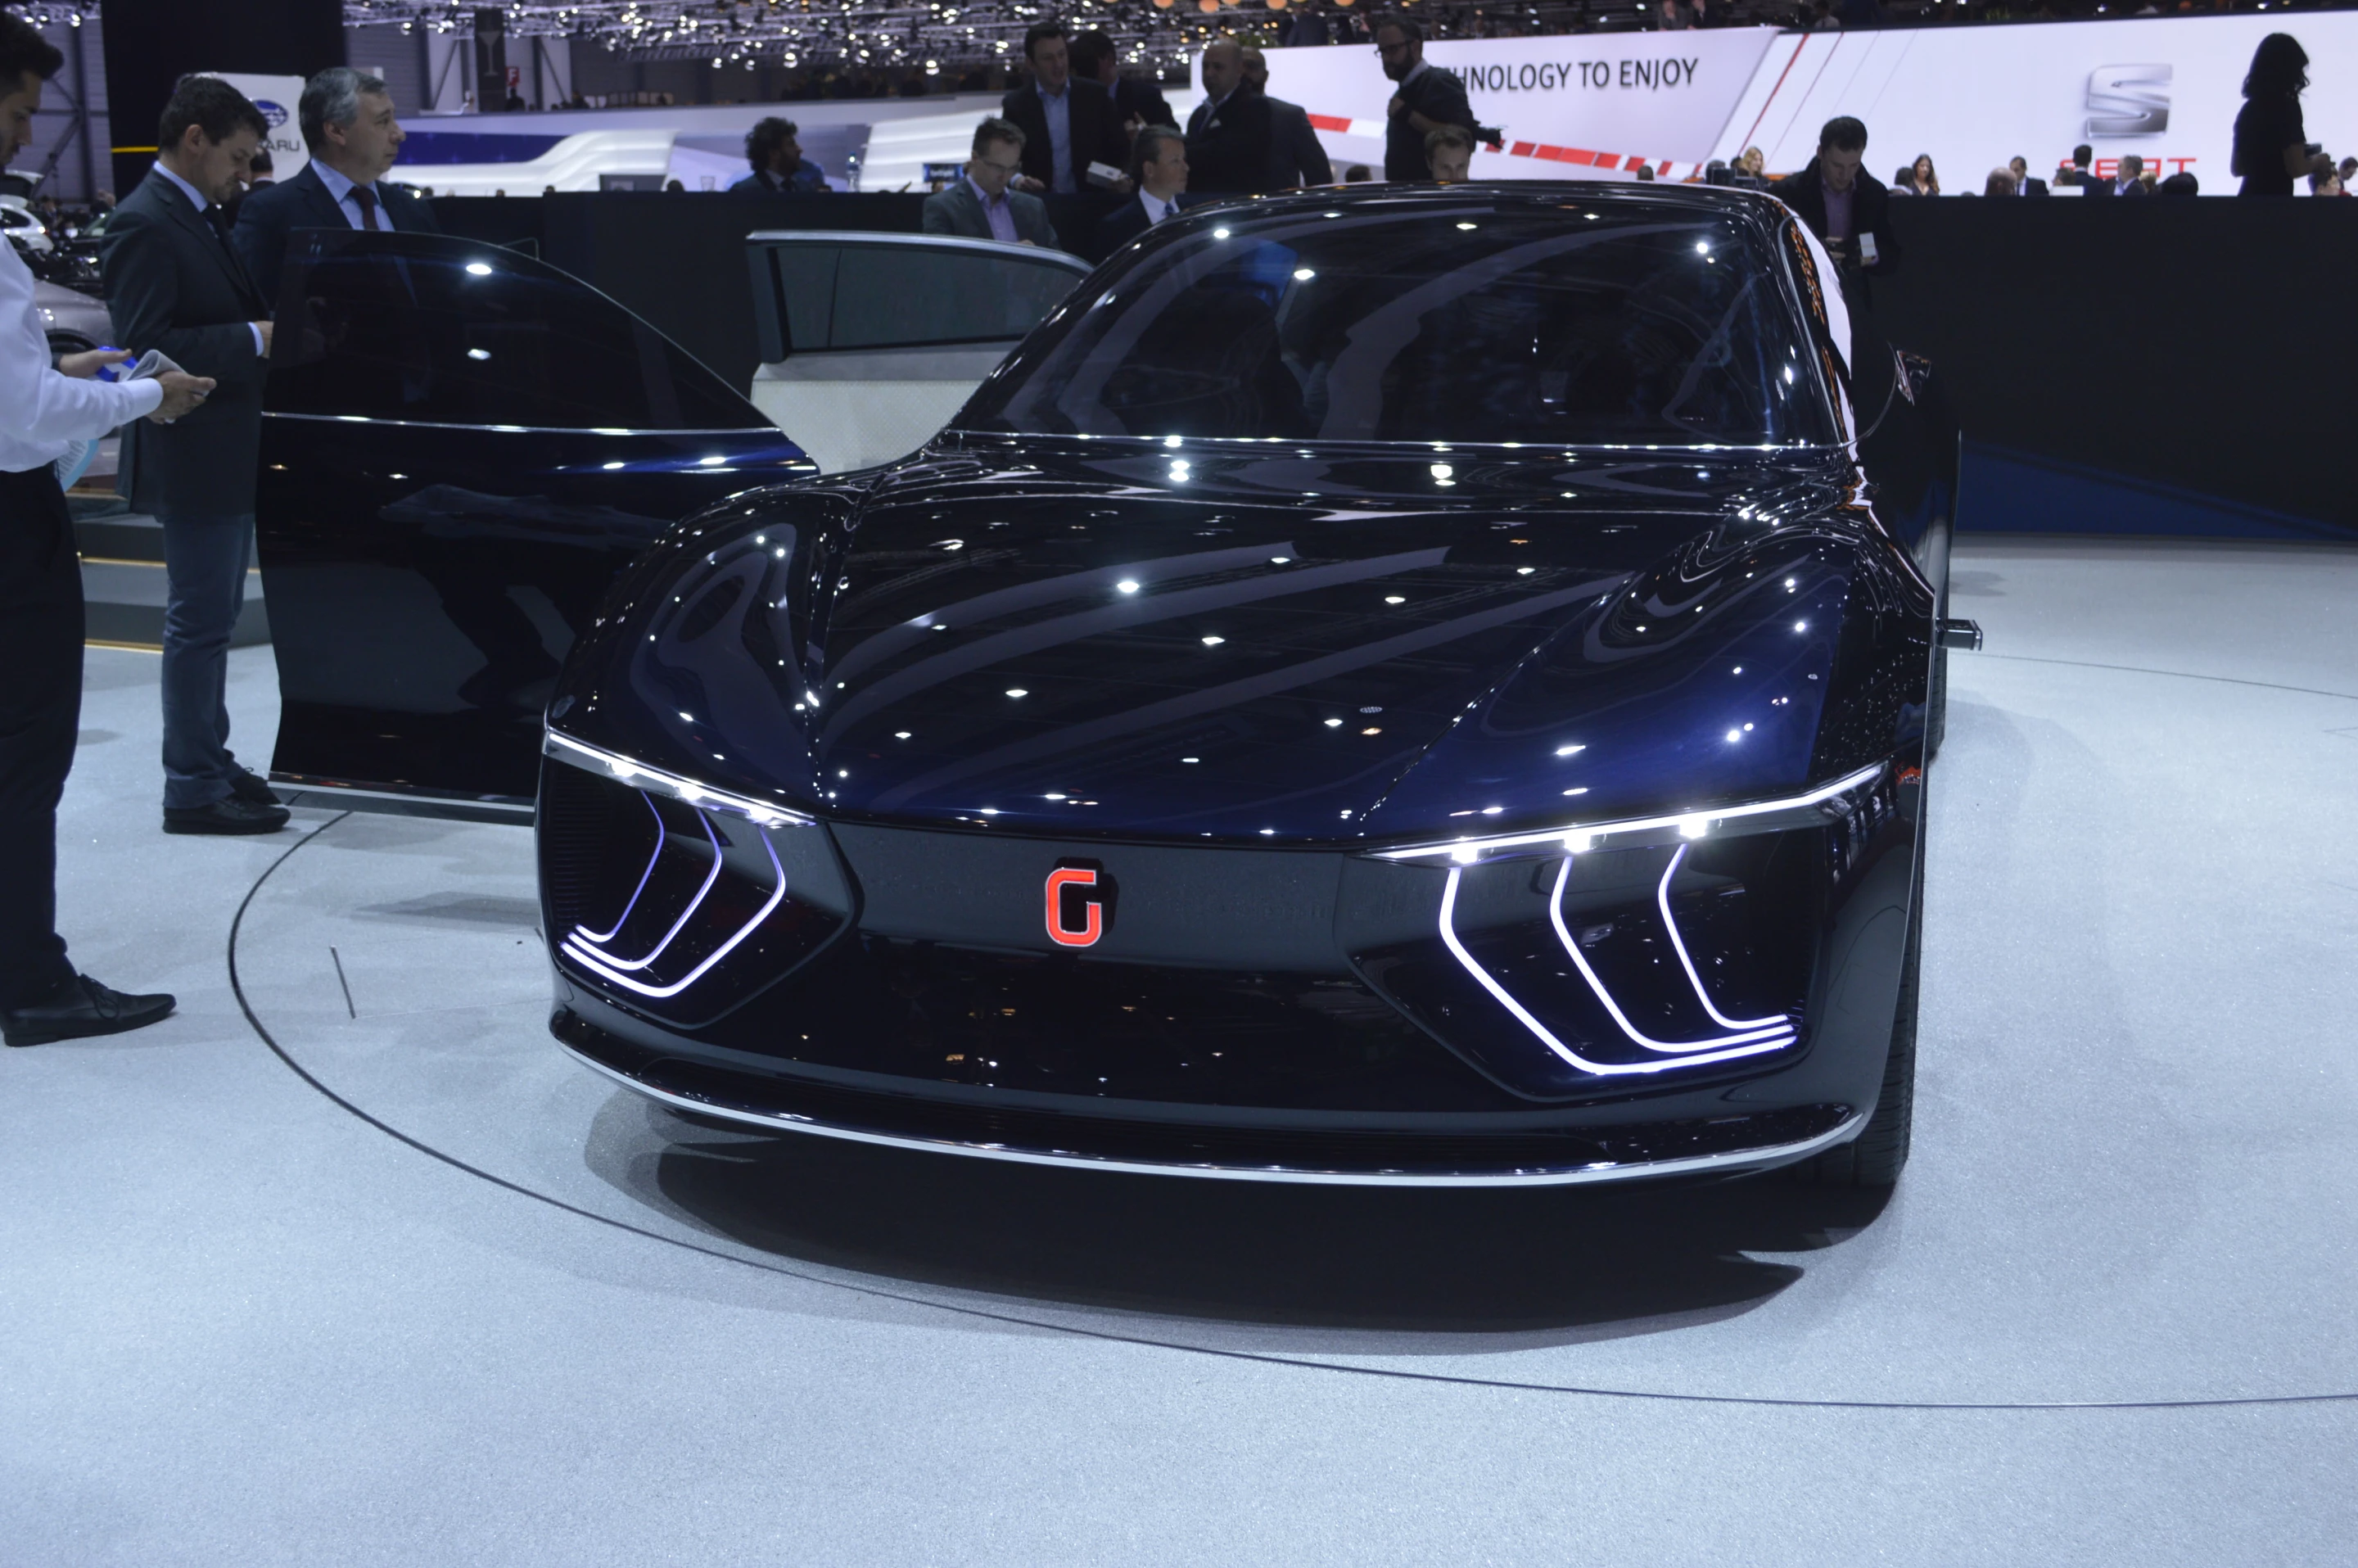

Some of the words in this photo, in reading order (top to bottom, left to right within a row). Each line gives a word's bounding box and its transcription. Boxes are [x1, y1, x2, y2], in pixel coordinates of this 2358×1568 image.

[1452, 61, 1572, 93] HNOLOGY
[1579, 61, 1610, 88] TO
[1619, 57, 1699, 92] ENJOY
[266, 138, 300, 152] ARU
[1045, 867, 1102, 947] G
